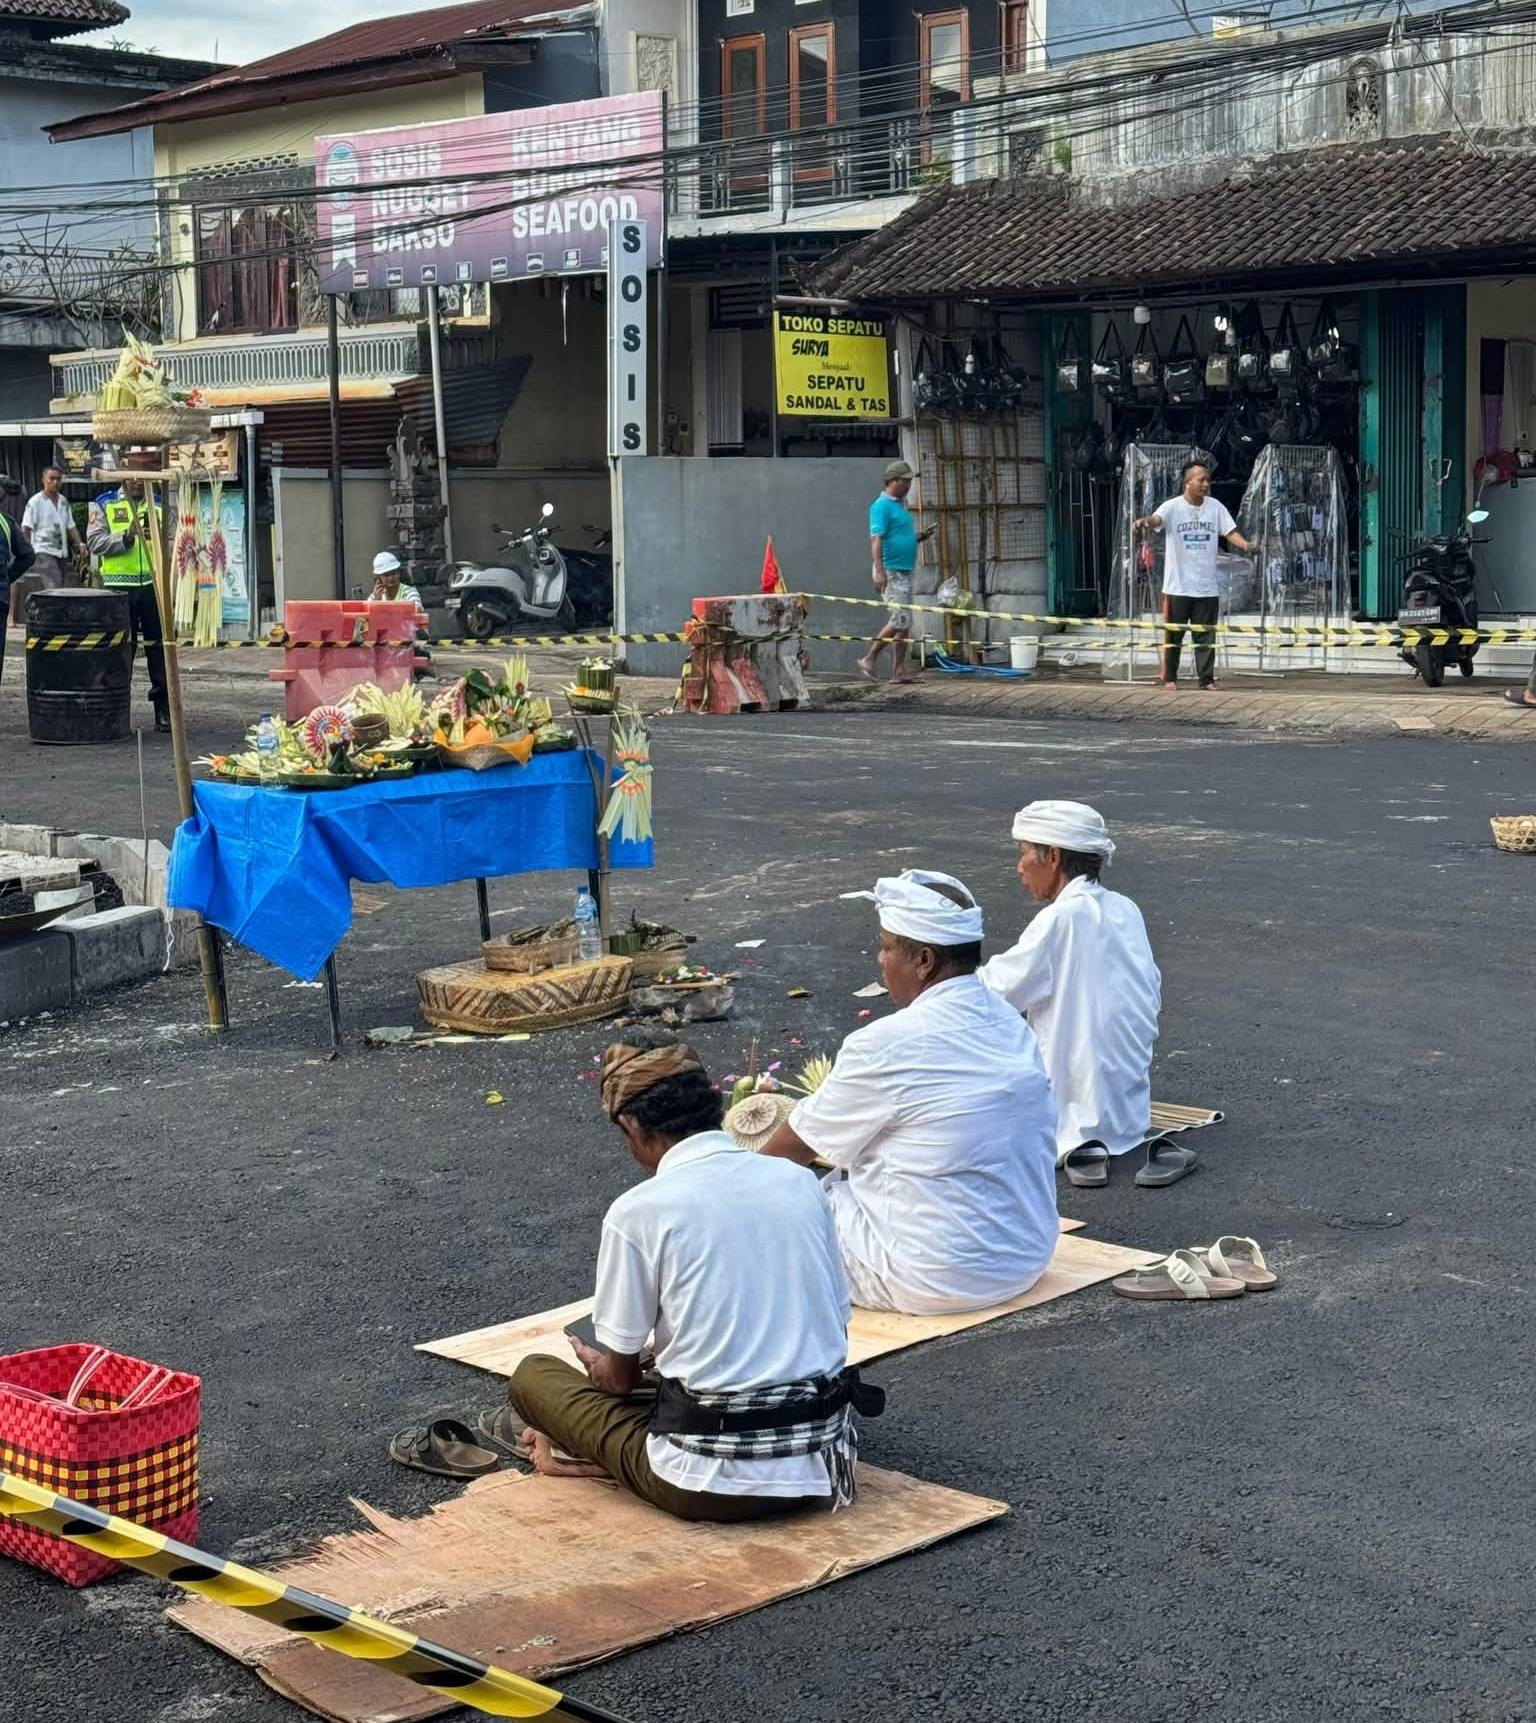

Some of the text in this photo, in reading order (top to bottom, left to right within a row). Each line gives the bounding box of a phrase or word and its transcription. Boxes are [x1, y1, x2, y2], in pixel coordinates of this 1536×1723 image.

[371, 143, 441, 180] SOSIS
[511, 195, 639, 239] SEAFOOD
[782, 315, 883, 336] TOKO SEPATU
[621, 225, 643, 451] SOSIS
[791, 338, 830, 358] SURYA
[807, 374, 866, 392] SEPATU
[786, 394, 887, 412] SANDAL & TAS
